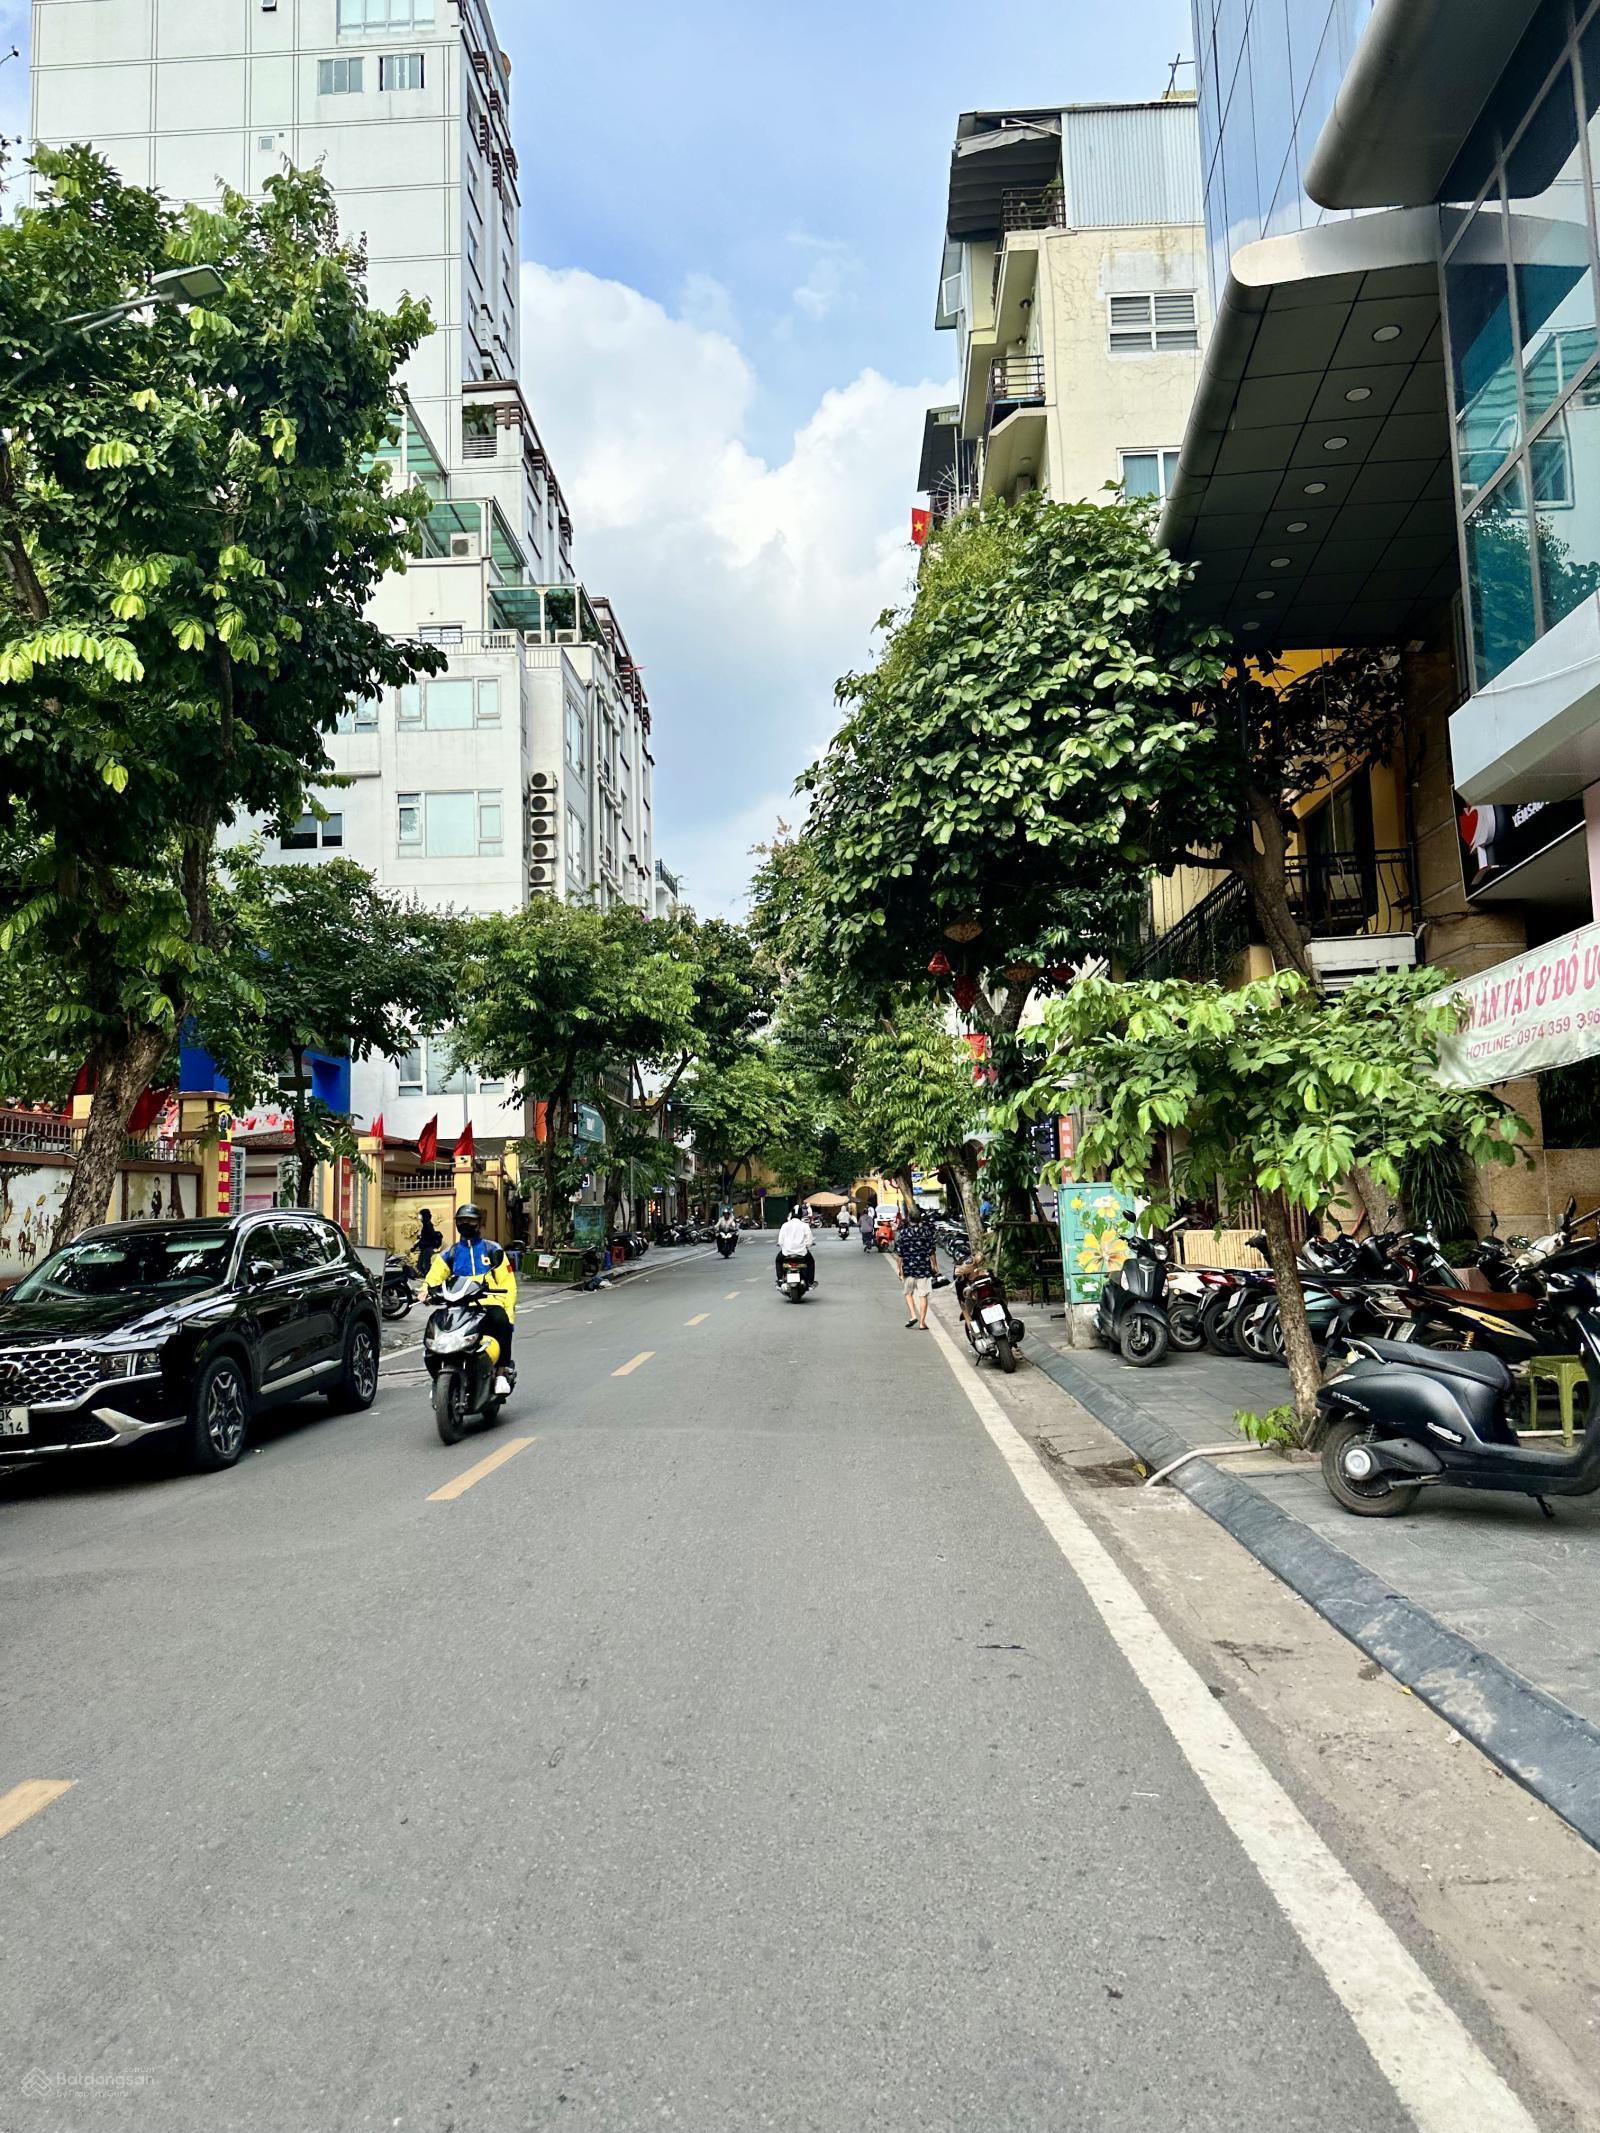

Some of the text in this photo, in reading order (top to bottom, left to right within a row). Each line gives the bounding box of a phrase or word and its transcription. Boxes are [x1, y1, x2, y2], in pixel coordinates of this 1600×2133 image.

[1466, 1033, 1515, 1061] HOTLINE:
[1517, 1023, 1545, 1046] 0974
[1547, 1015, 1571, 1037] 359
